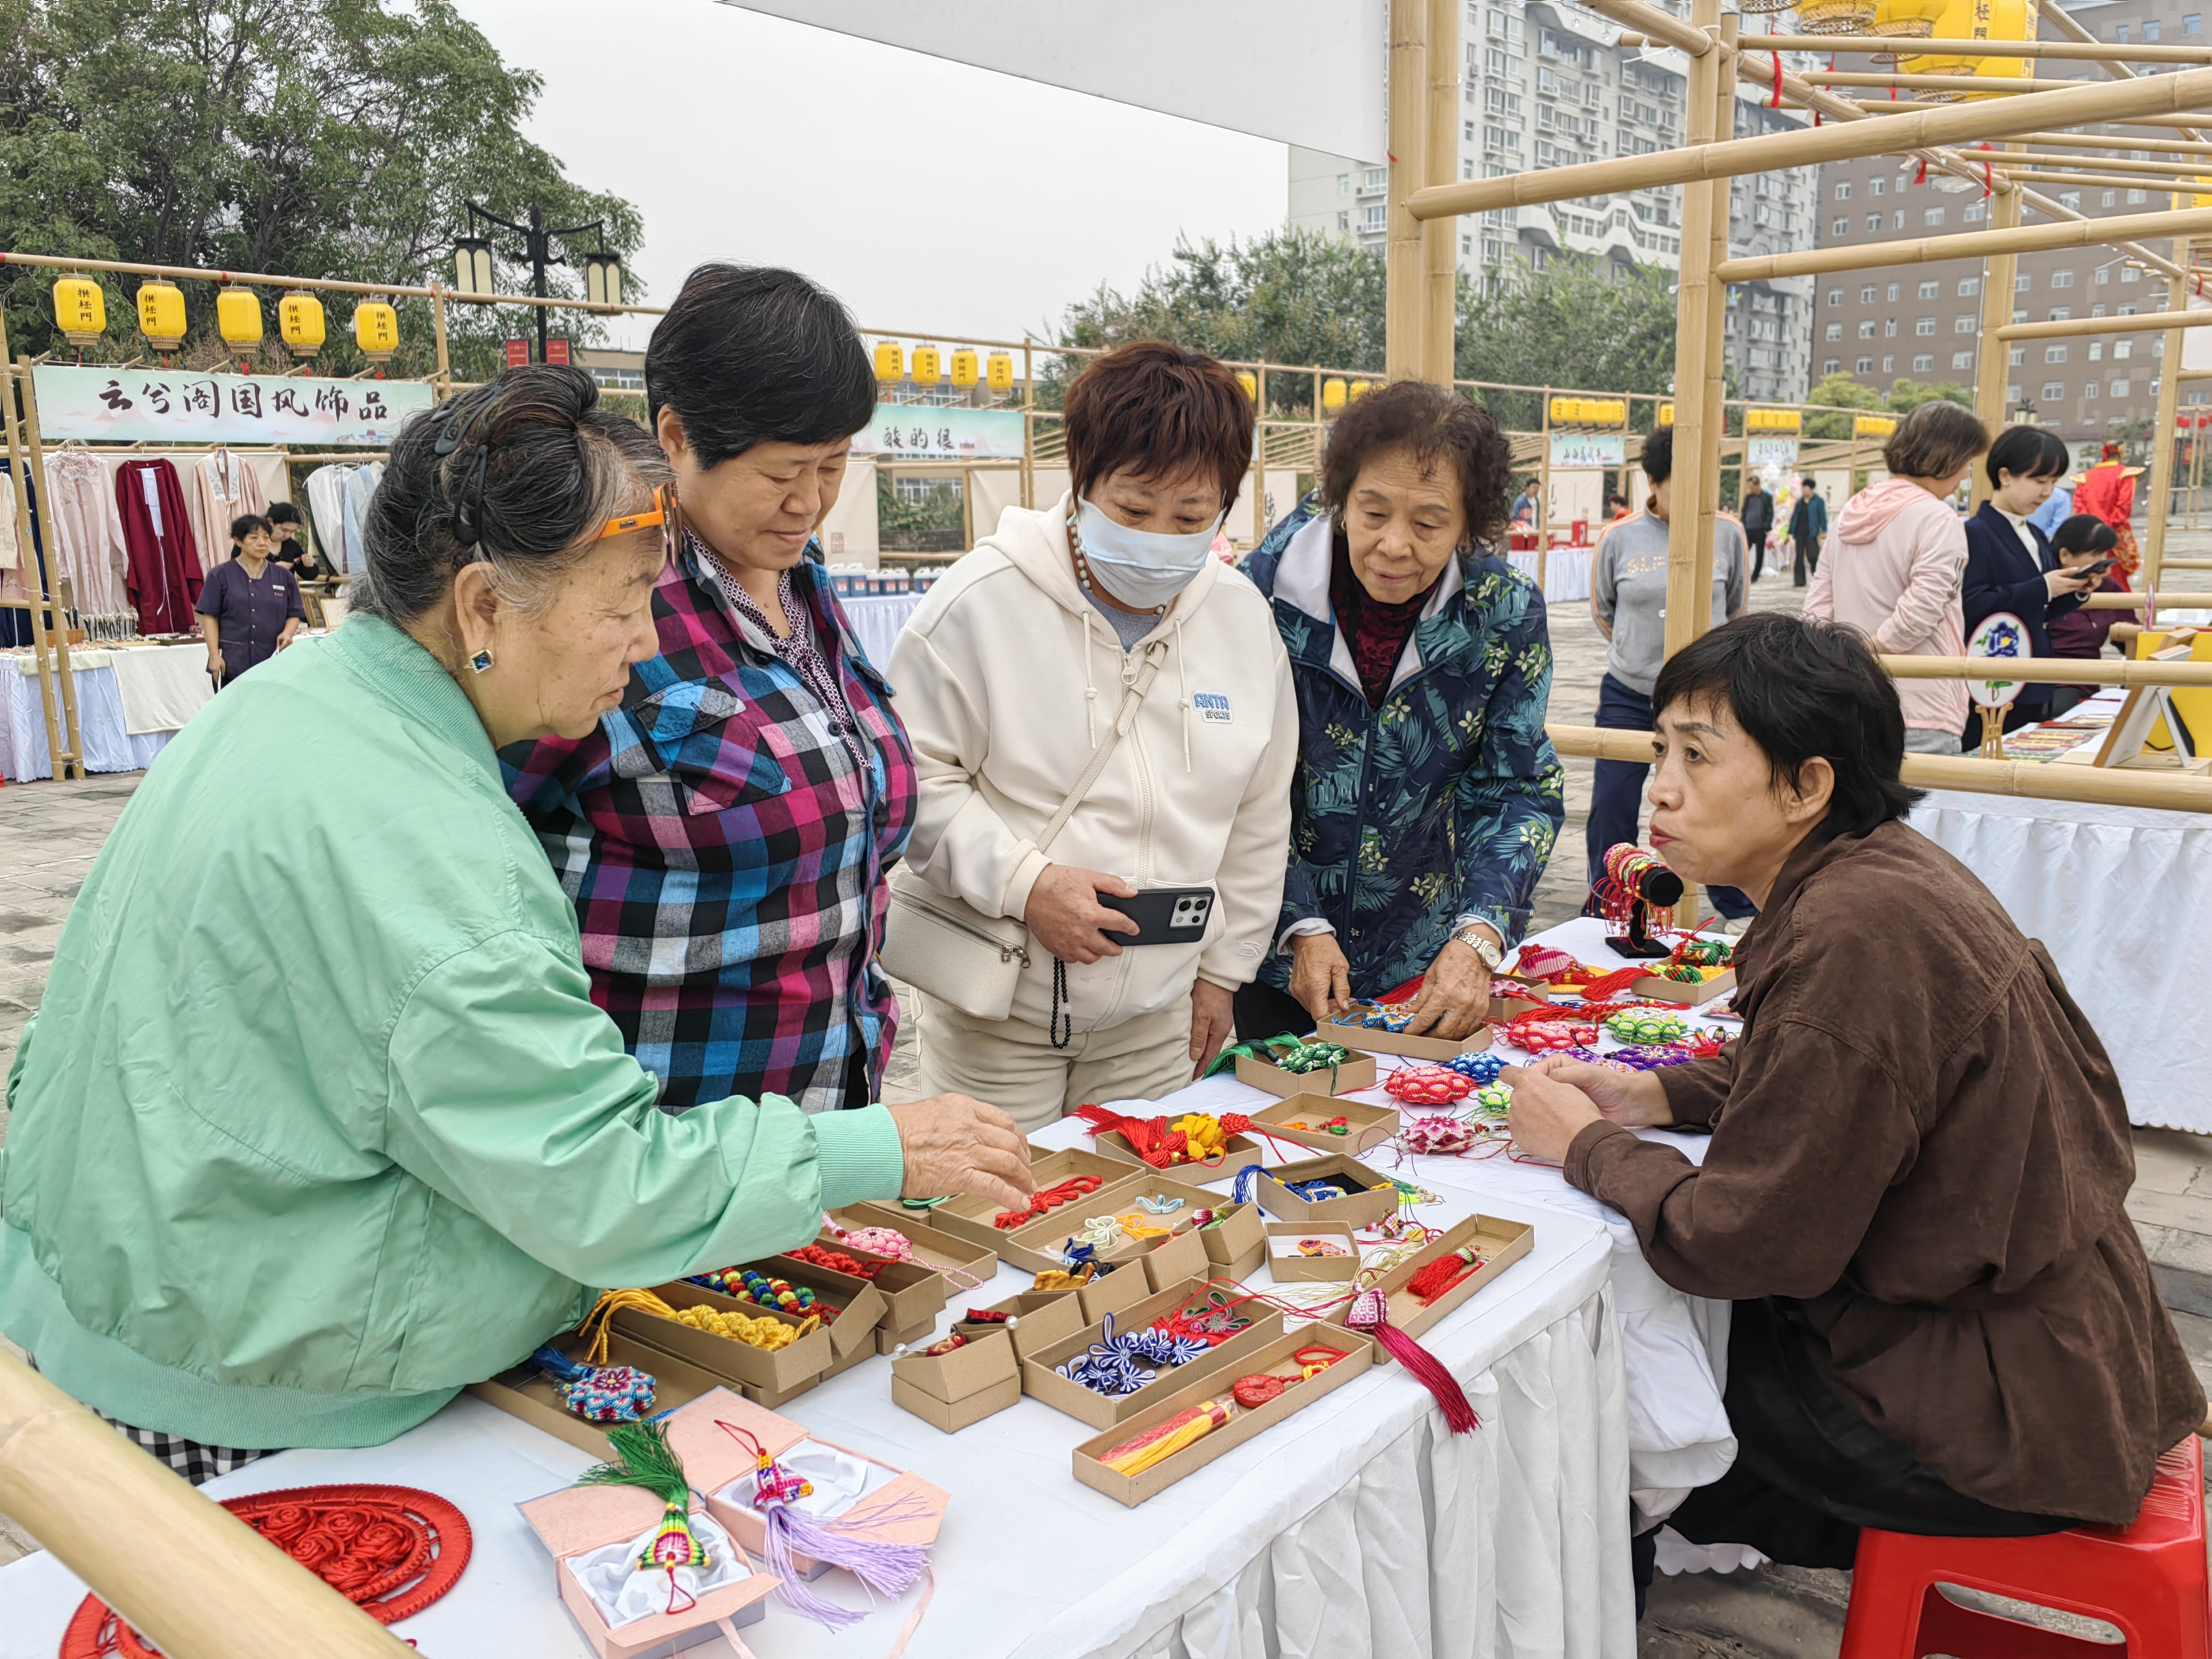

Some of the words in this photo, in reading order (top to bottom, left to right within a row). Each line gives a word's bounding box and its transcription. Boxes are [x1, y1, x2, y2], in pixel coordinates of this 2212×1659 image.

[99, 380, 388, 422] 云兮阁国风饰品
[883, 426, 955, 450] 酸的很
[1194, 693, 1230, 710] ANTA
[1205, 710, 1231, 720] SPORTS
